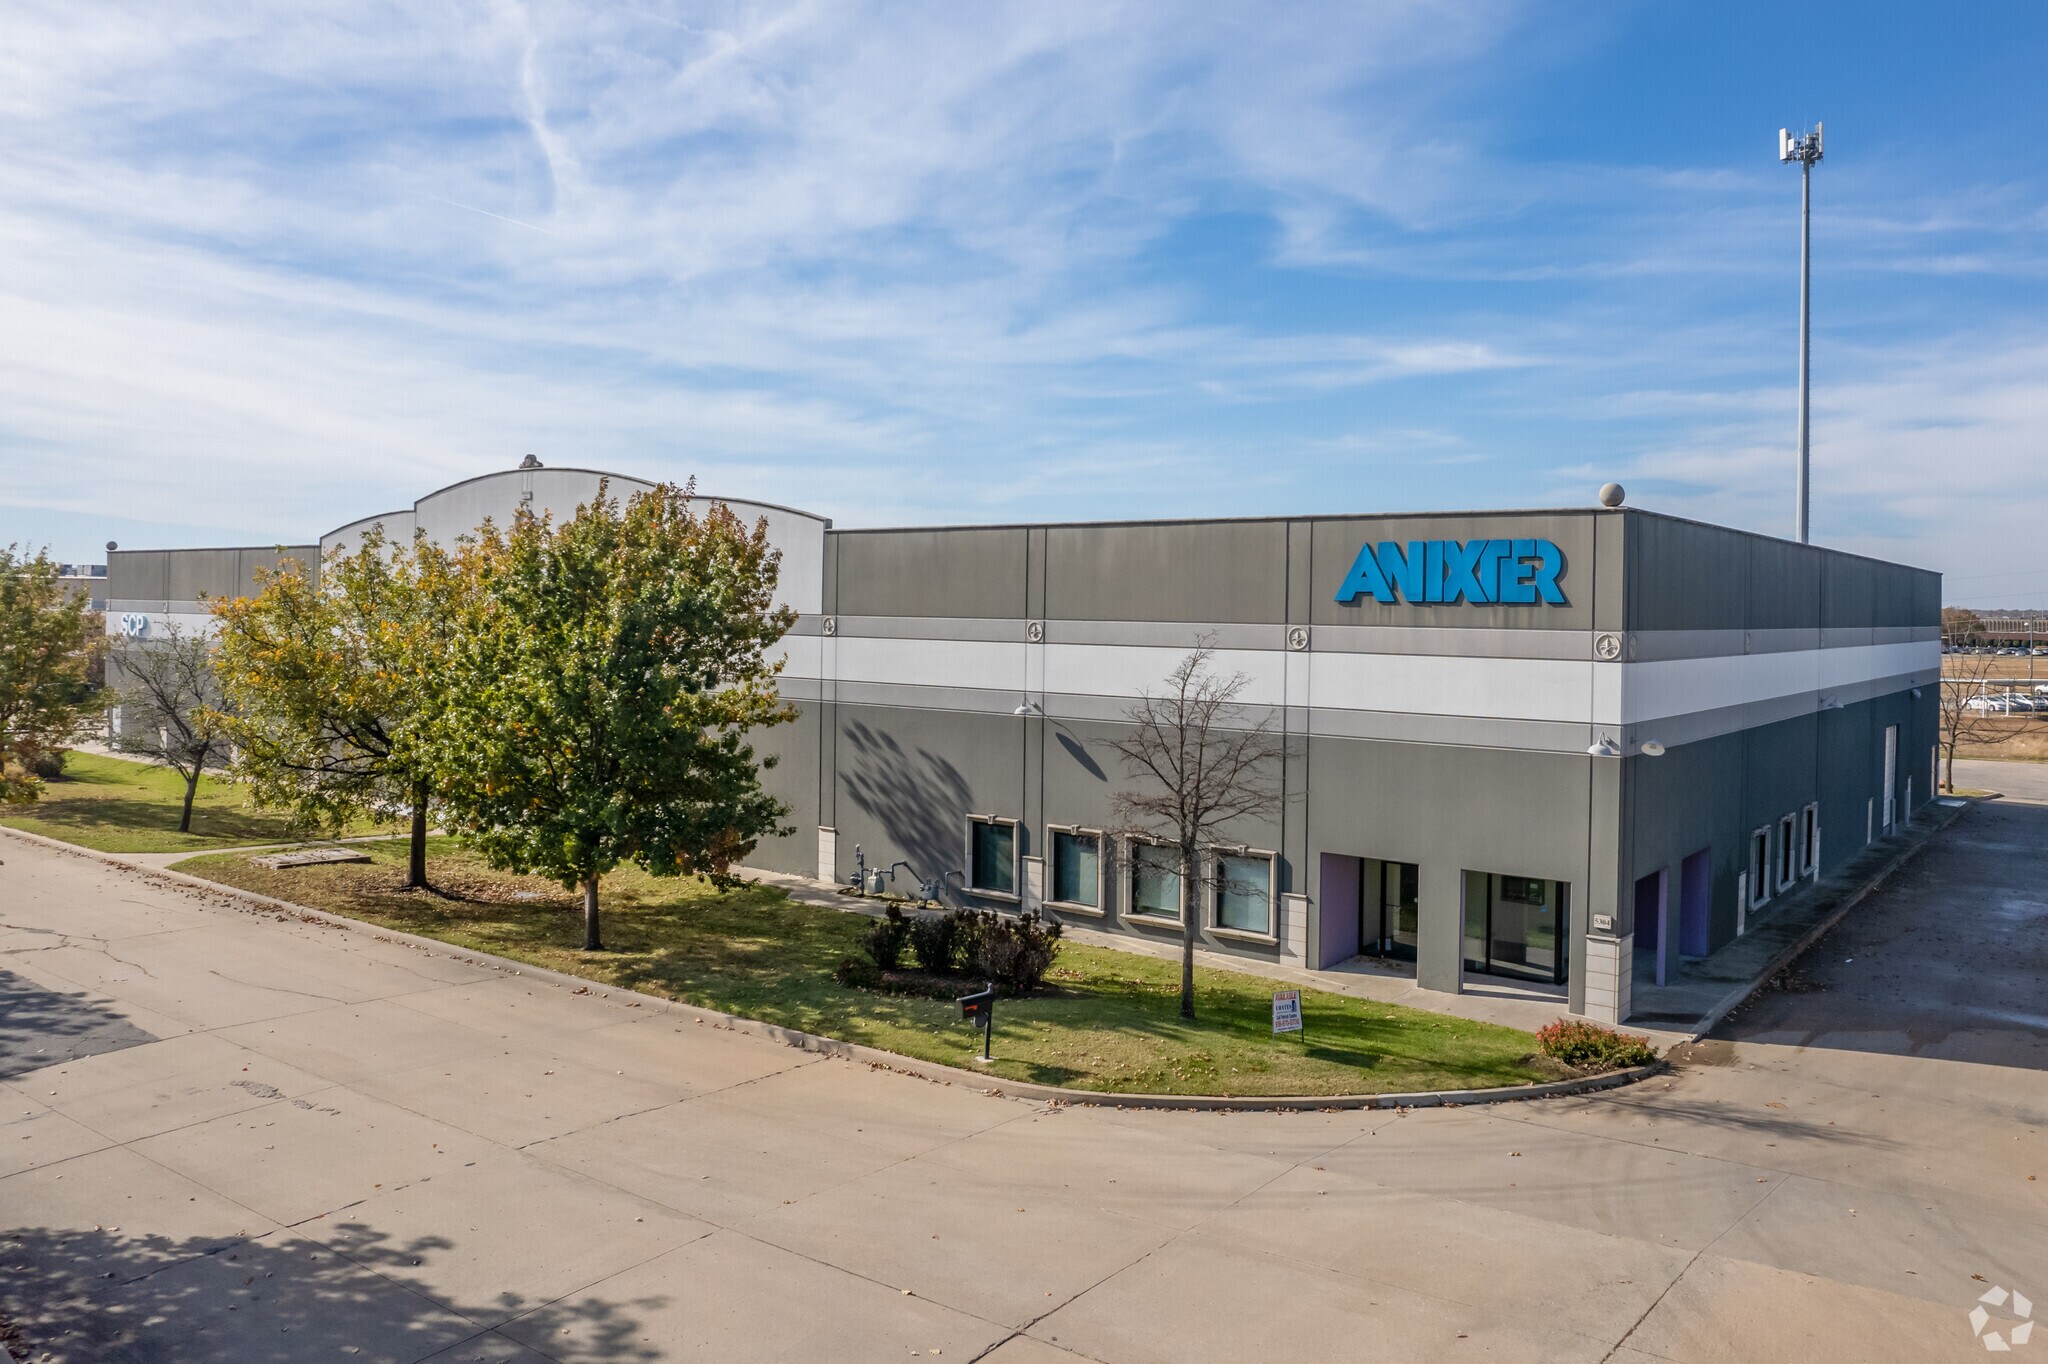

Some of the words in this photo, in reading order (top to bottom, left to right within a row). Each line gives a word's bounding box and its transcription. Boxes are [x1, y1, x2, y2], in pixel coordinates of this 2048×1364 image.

[1334, 539, 1568, 604] ANIXTER
[122, 614, 144, 636] SCP
[1275, 992, 1296, 1001] AVAILABLE
